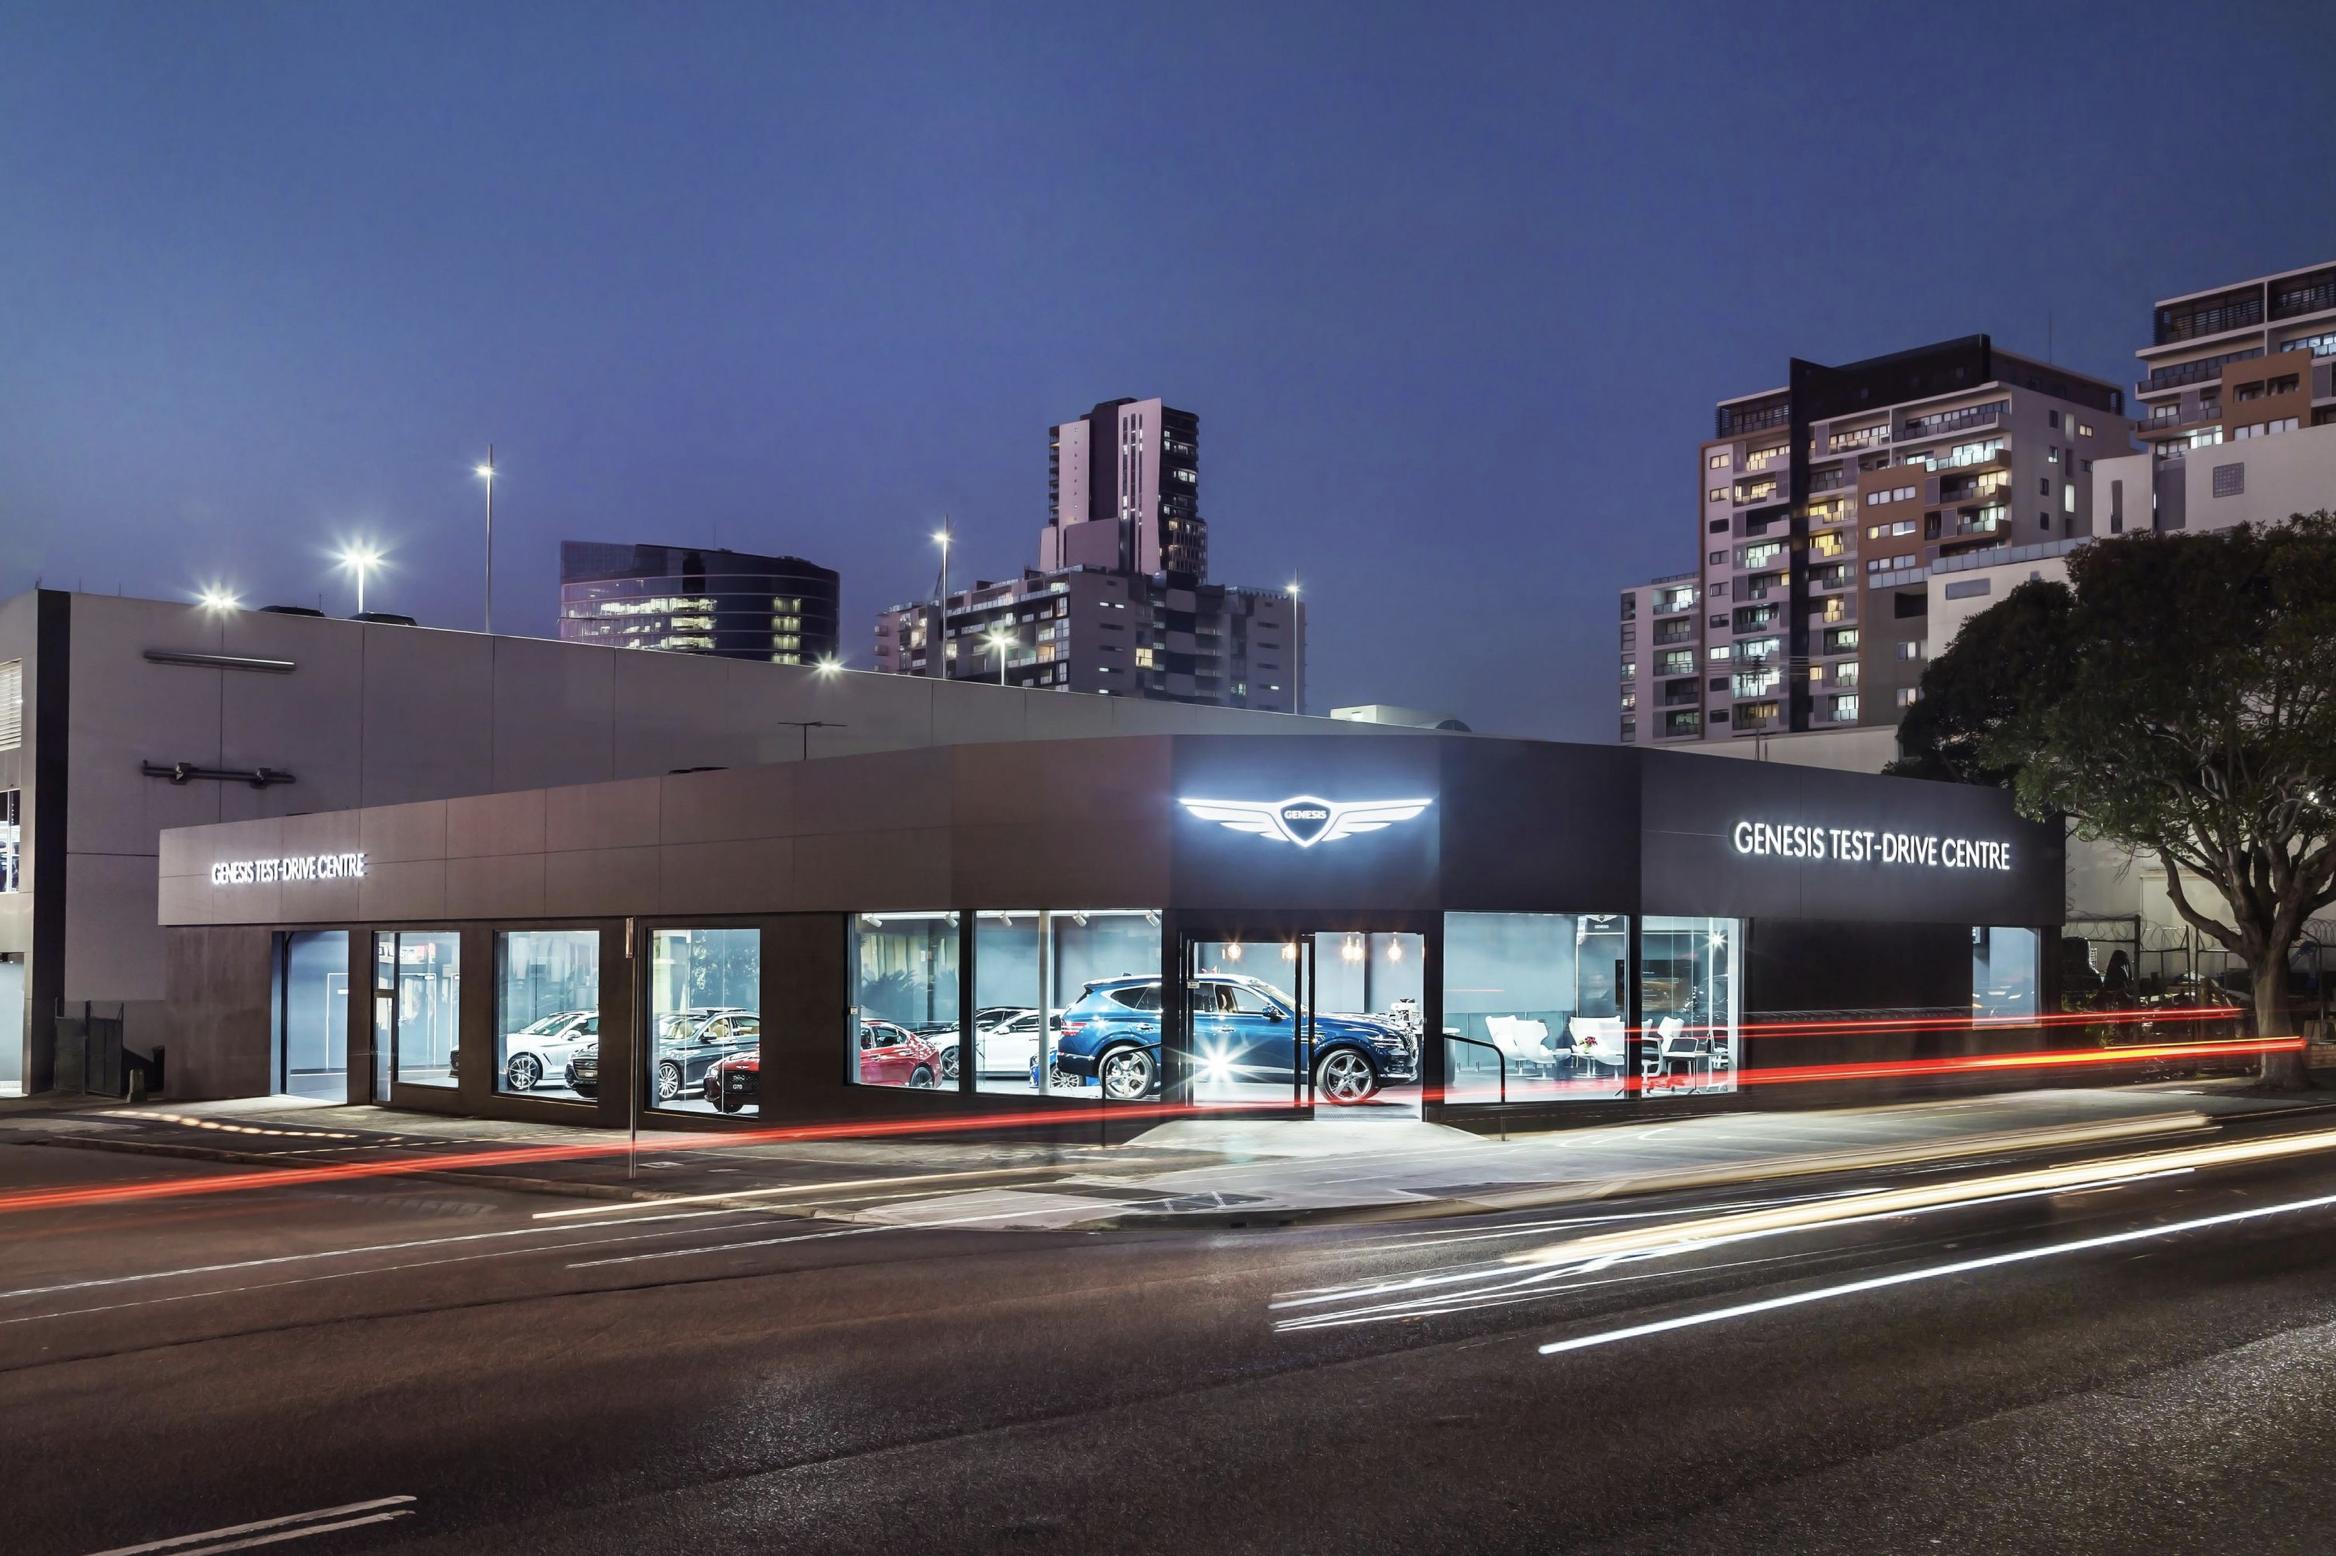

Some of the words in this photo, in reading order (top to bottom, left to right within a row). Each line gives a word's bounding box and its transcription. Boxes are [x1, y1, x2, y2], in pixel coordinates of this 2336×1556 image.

[1734, 821, 1825, 859] GENESIS
[1829, 829, 1938, 866] TEST-DRIVE
[1941, 838, 2011, 870] CENTRE
[211, 861, 254, 885] GENESIS
[254, 856, 317, 882] TEST-DRIVE
[317, 853, 365, 878] CENTRE
